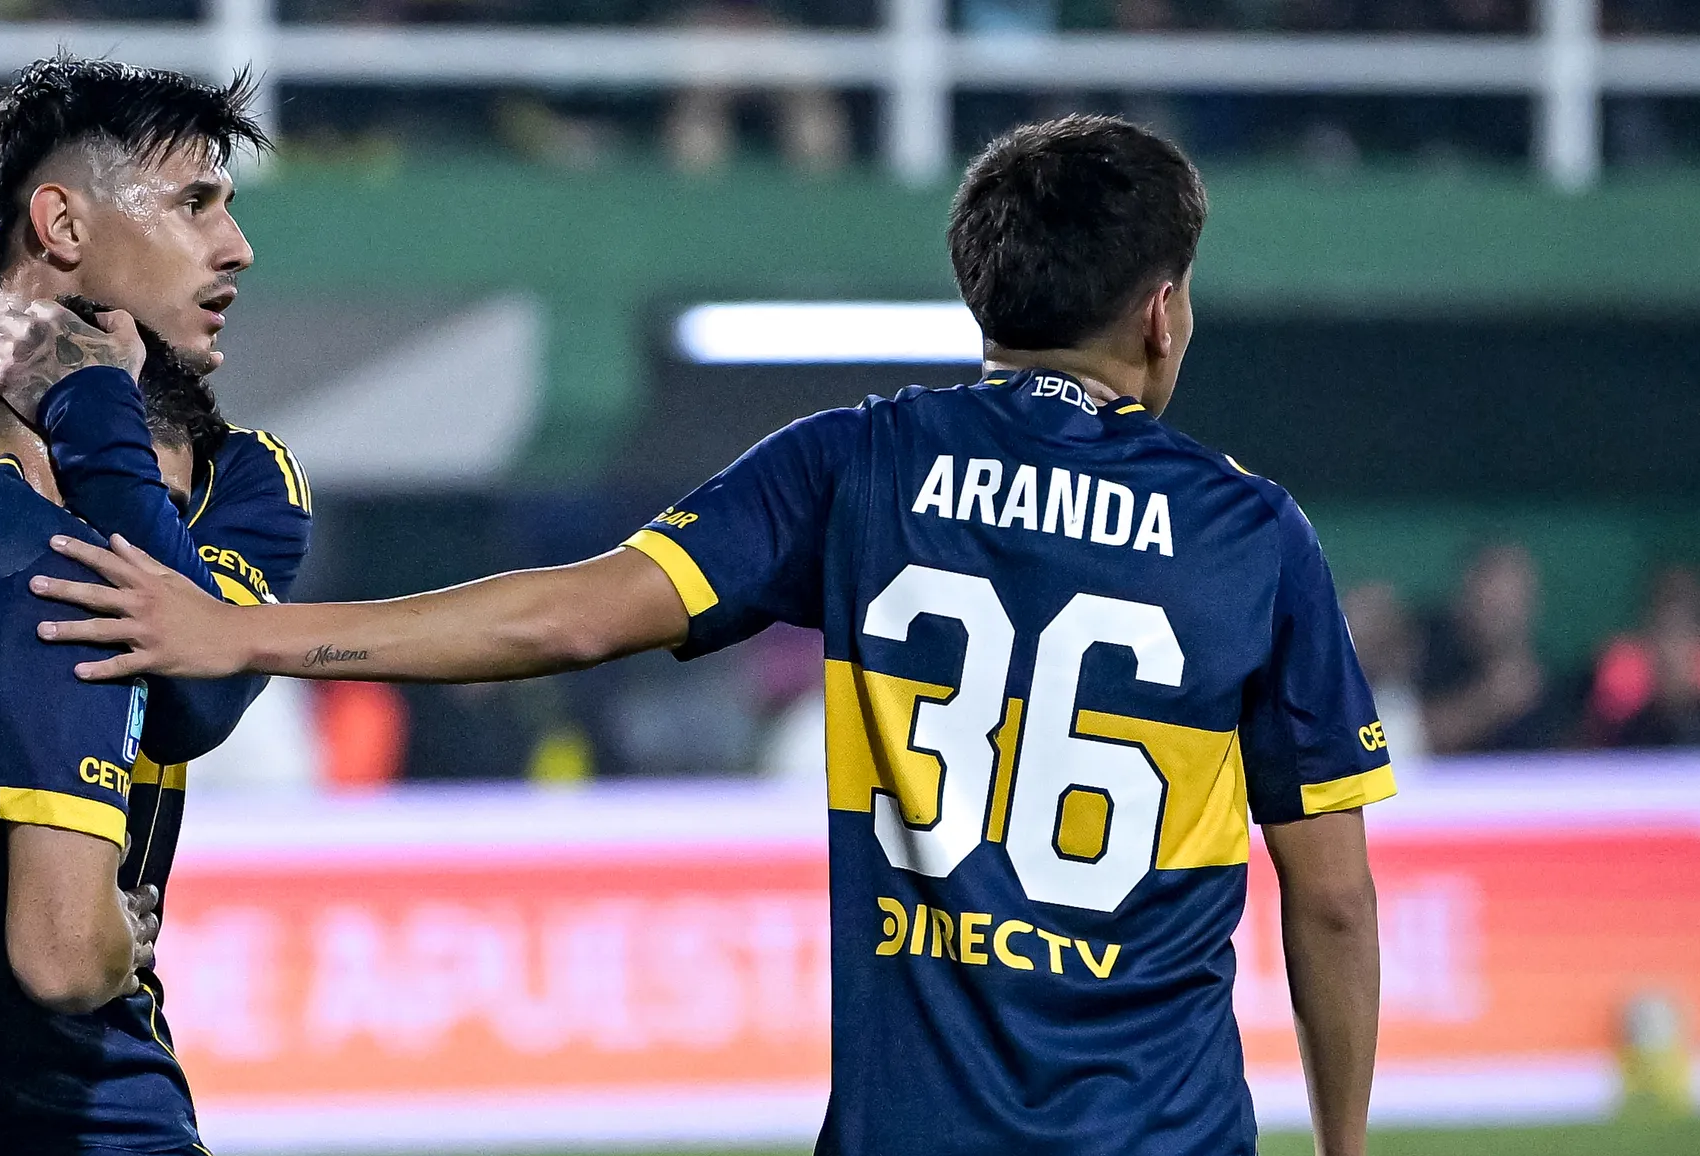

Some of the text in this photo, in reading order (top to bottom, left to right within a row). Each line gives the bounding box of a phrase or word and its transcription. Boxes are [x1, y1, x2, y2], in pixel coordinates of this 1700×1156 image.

[1031, 376, 1098, 416] 1905
[912, 455, 1173, 557] ARANDA
[197, 545, 281, 604] CETRO
[862, 563, 1185, 913] 36
[1358, 720, 1387, 752] CE
[875, 896, 1122, 979] DIRECTV
